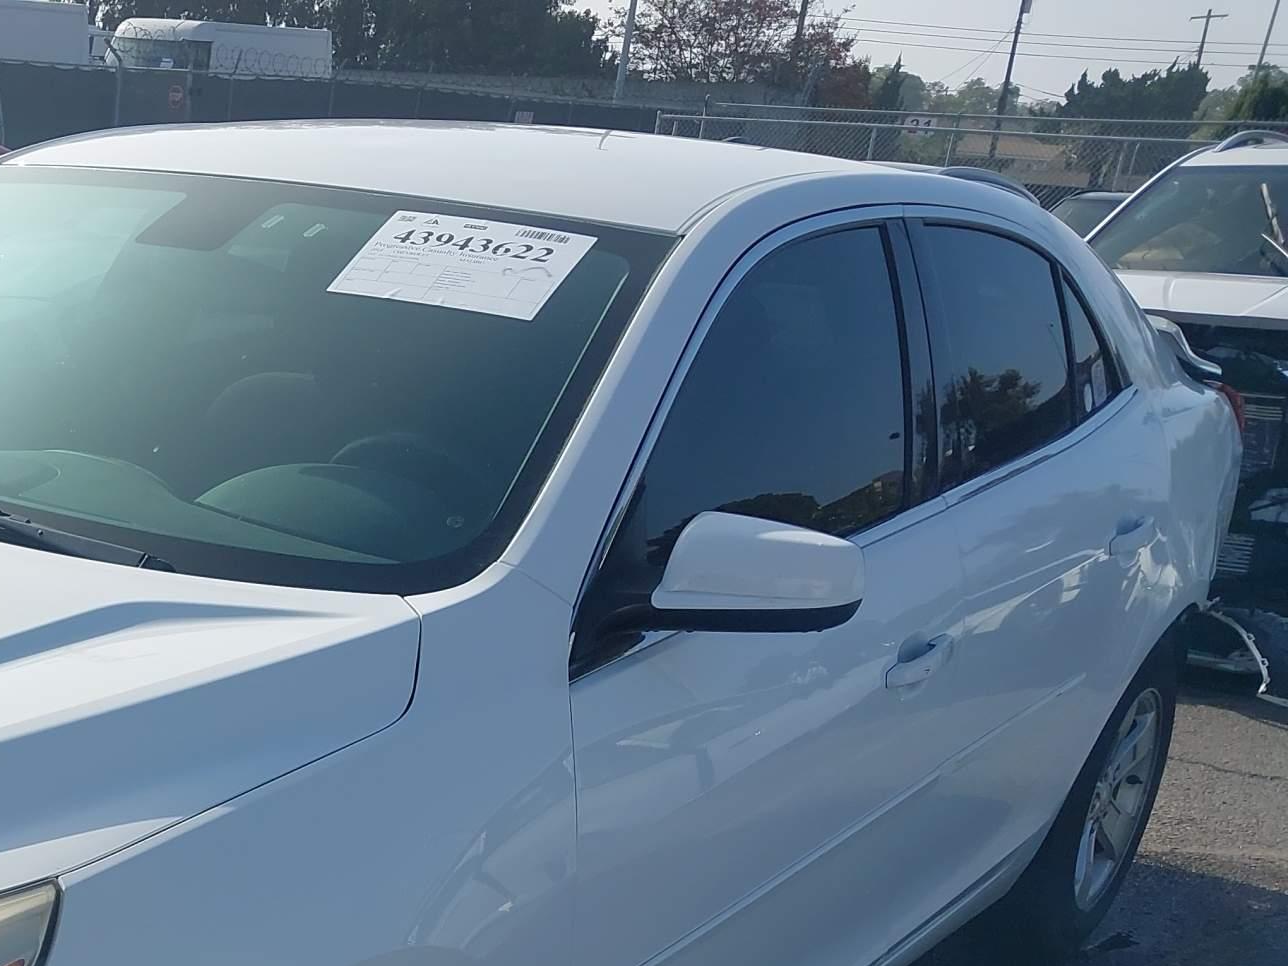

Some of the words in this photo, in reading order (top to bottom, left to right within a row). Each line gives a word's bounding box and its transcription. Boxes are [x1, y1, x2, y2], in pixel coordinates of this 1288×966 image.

[393, 229, 555, 263] 43943622
[422, 246, 456, 257] Casualty
[459, 251, 499, 262] Insurance
